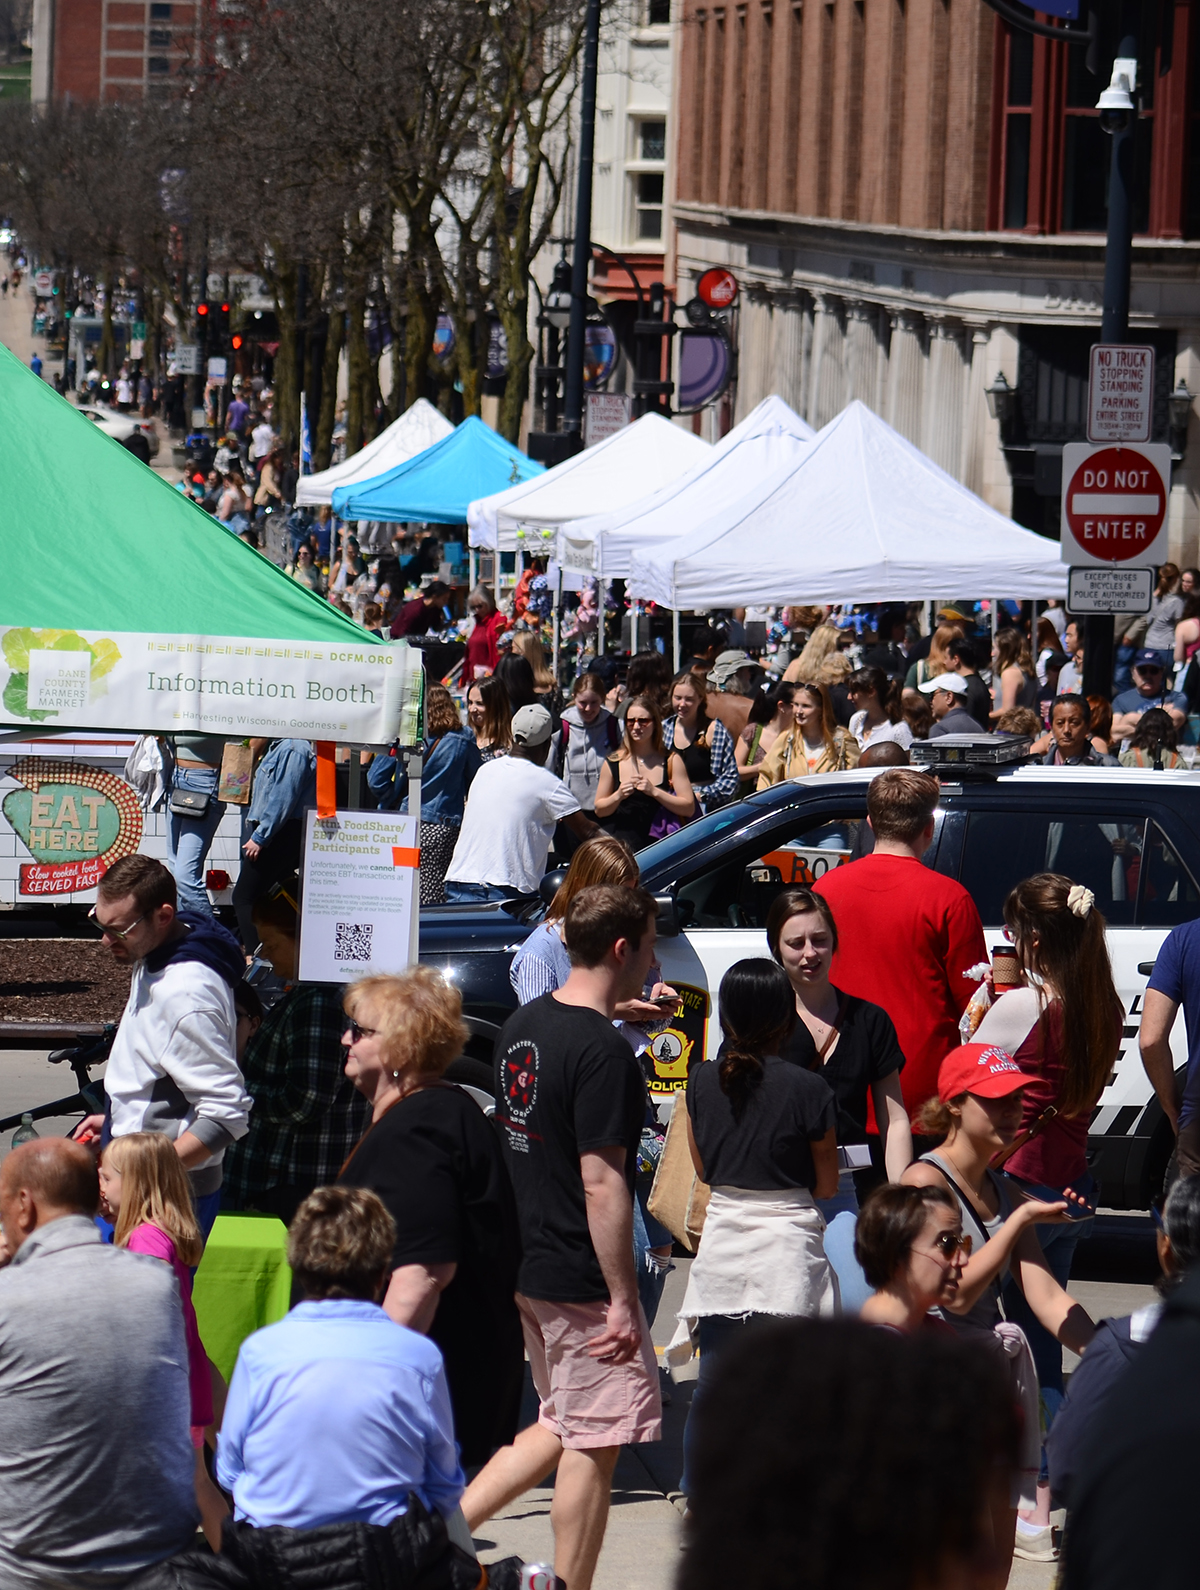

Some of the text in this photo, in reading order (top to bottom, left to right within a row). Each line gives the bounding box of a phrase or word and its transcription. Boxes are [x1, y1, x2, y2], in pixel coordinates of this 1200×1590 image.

[1098, 351, 1146, 368] NO TRUCK
[1100, 368, 1143, 380] STOPPING
[1100, 381, 1143, 393] STANDING
[1101, 397, 1139, 409] PARKING
[1121, 411, 1144, 422] STREET
[1083, 469, 1149, 489] DO NOT
[1084, 522, 1146, 539] ENTER
[1084, 573, 1110, 581] EXCEPT
[1090, 582, 1123, 590] BICYCLES
[329, 652, 393, 665] DCFM.ORG
[58, 669, 86, 679] DANE
[44, 679, 86, 689] COUNTY
[147, 671, 376, 705] Information Booth
[38, 698, 85, 708] MARKET
[182, 711, 338, 731] Harvesting Wisconsin Goodness
[30, 794, 106, 829] EAT
[313, 819, 406, 833] Attn: FoodShare/
[29, 829, 99, 851] HERE
[312, 831, 398, 844] EBT/Quest Card
[312, 842, 380, 855] Participants
[27, 861, 98, 880] Slow cooked food
[311, 861, 357, 871] Unfortunately,
[27, 871, 102, 892] SERVED FAST
[310, 870, 337, 878] process
[353, 872, 395, 880] transactions
[680, 990, 703, 1010] STATE
